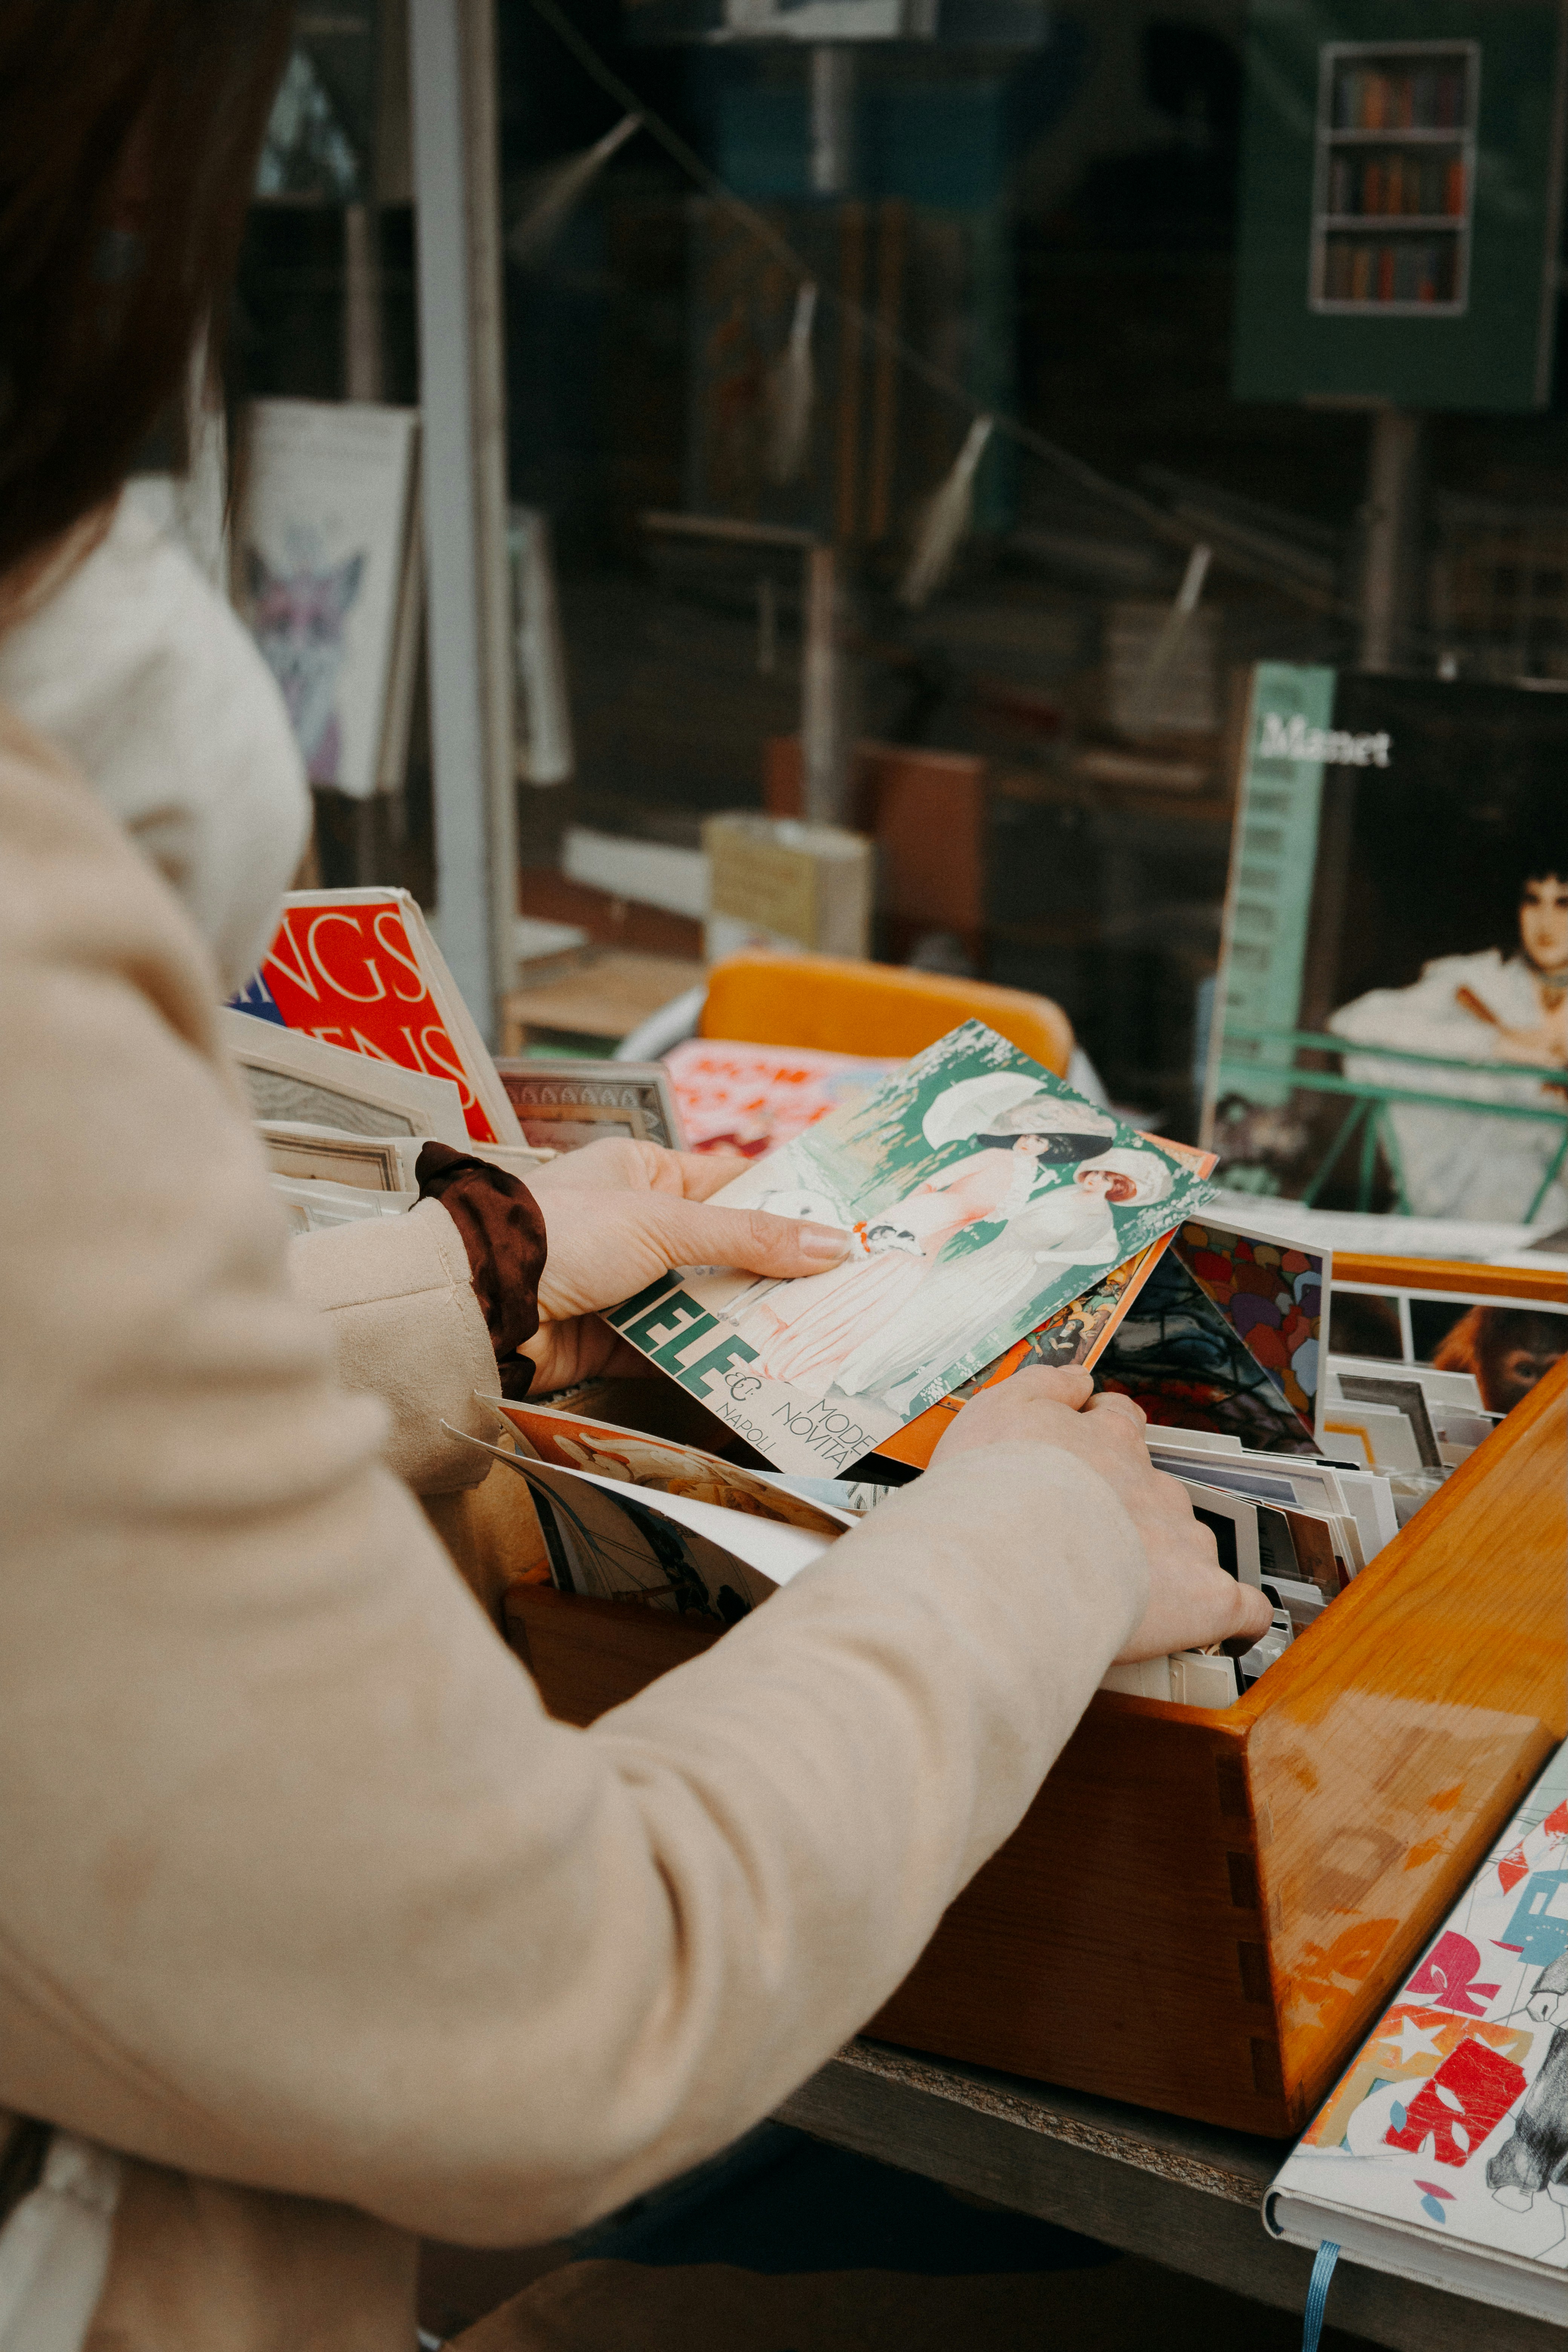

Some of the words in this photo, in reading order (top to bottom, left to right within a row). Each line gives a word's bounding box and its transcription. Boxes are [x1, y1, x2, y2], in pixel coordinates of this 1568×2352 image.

[1260, 713, 1392, 768] Manet
[716, 1402, 777, 1453] NAPOLI
[771, 1401, 853, 1470] NOVITÀ
[807, 1398, 879, 1456] MODE
